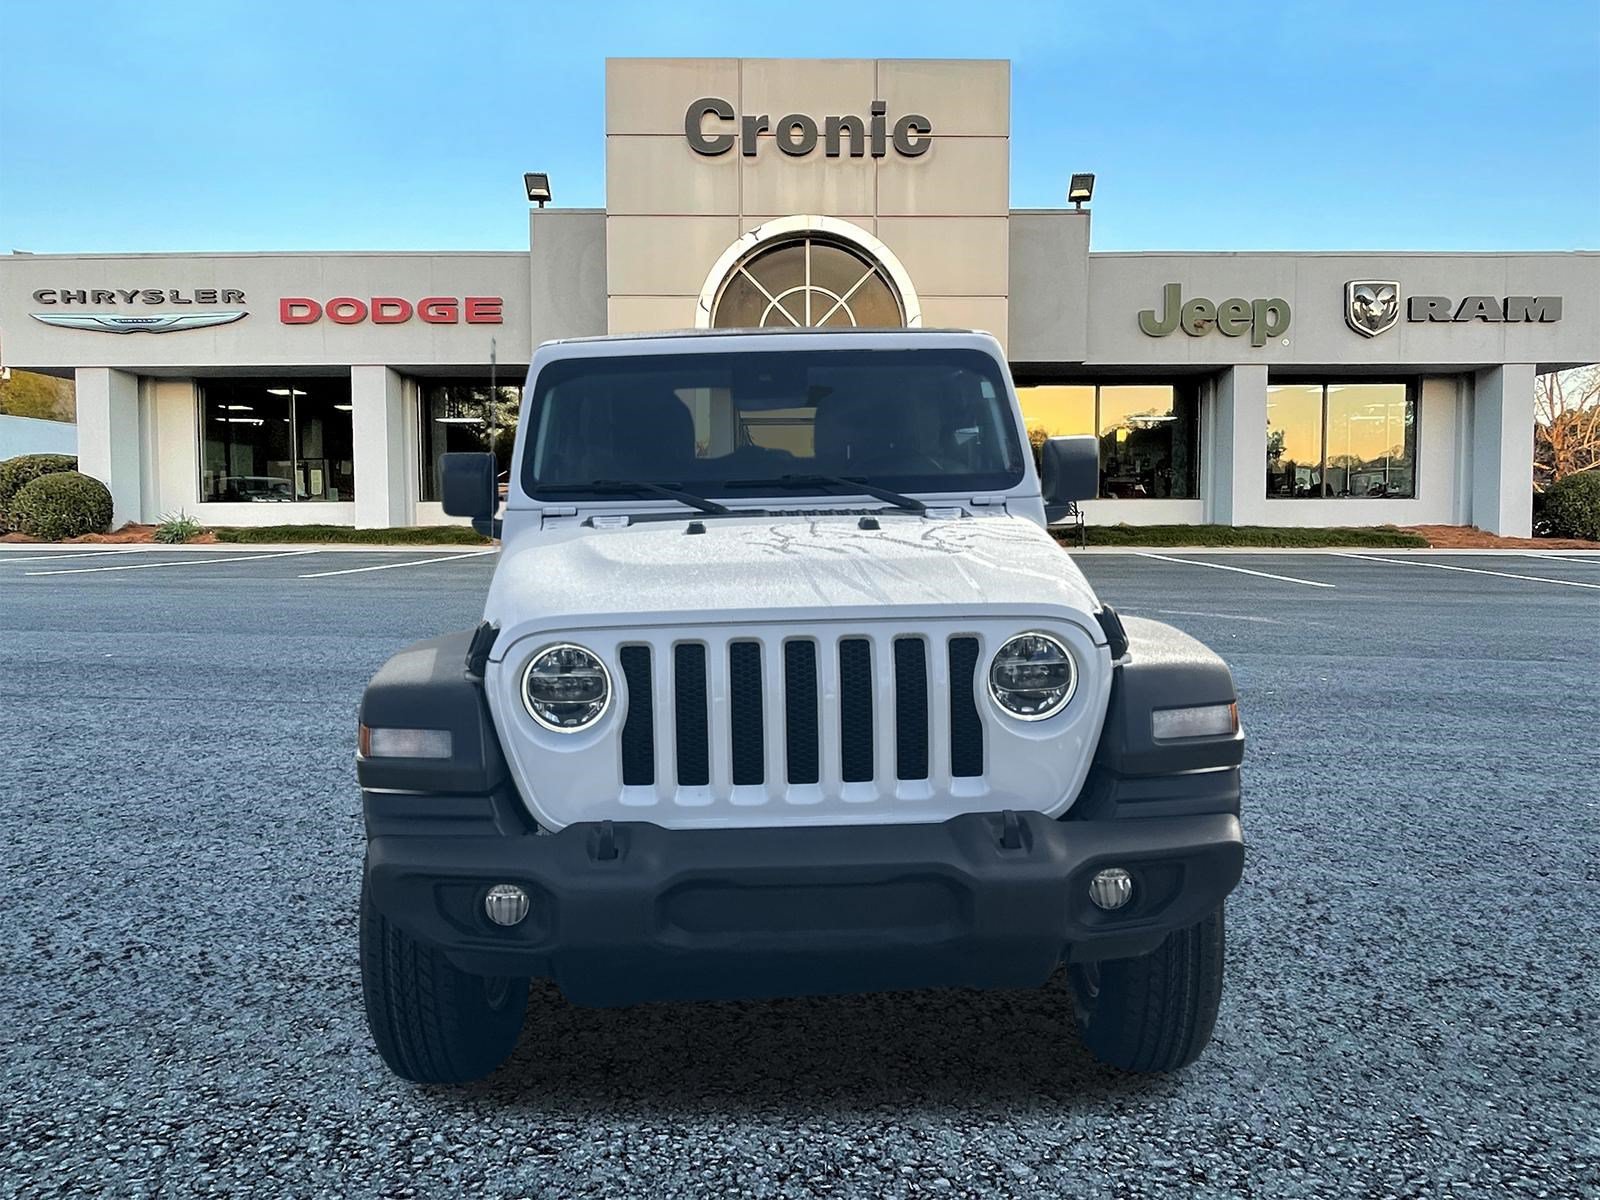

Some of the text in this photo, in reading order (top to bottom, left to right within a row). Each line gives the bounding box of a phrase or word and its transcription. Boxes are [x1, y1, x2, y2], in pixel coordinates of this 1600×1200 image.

[685, 97, 932, 157] Cronic
[32, 289, 247, 305] CHRYSLER
[279, 297, 503, 324] DODGE
[1407, 296, 1563, 323] RAM
[1138, 283, 1291, 347] Jeep
